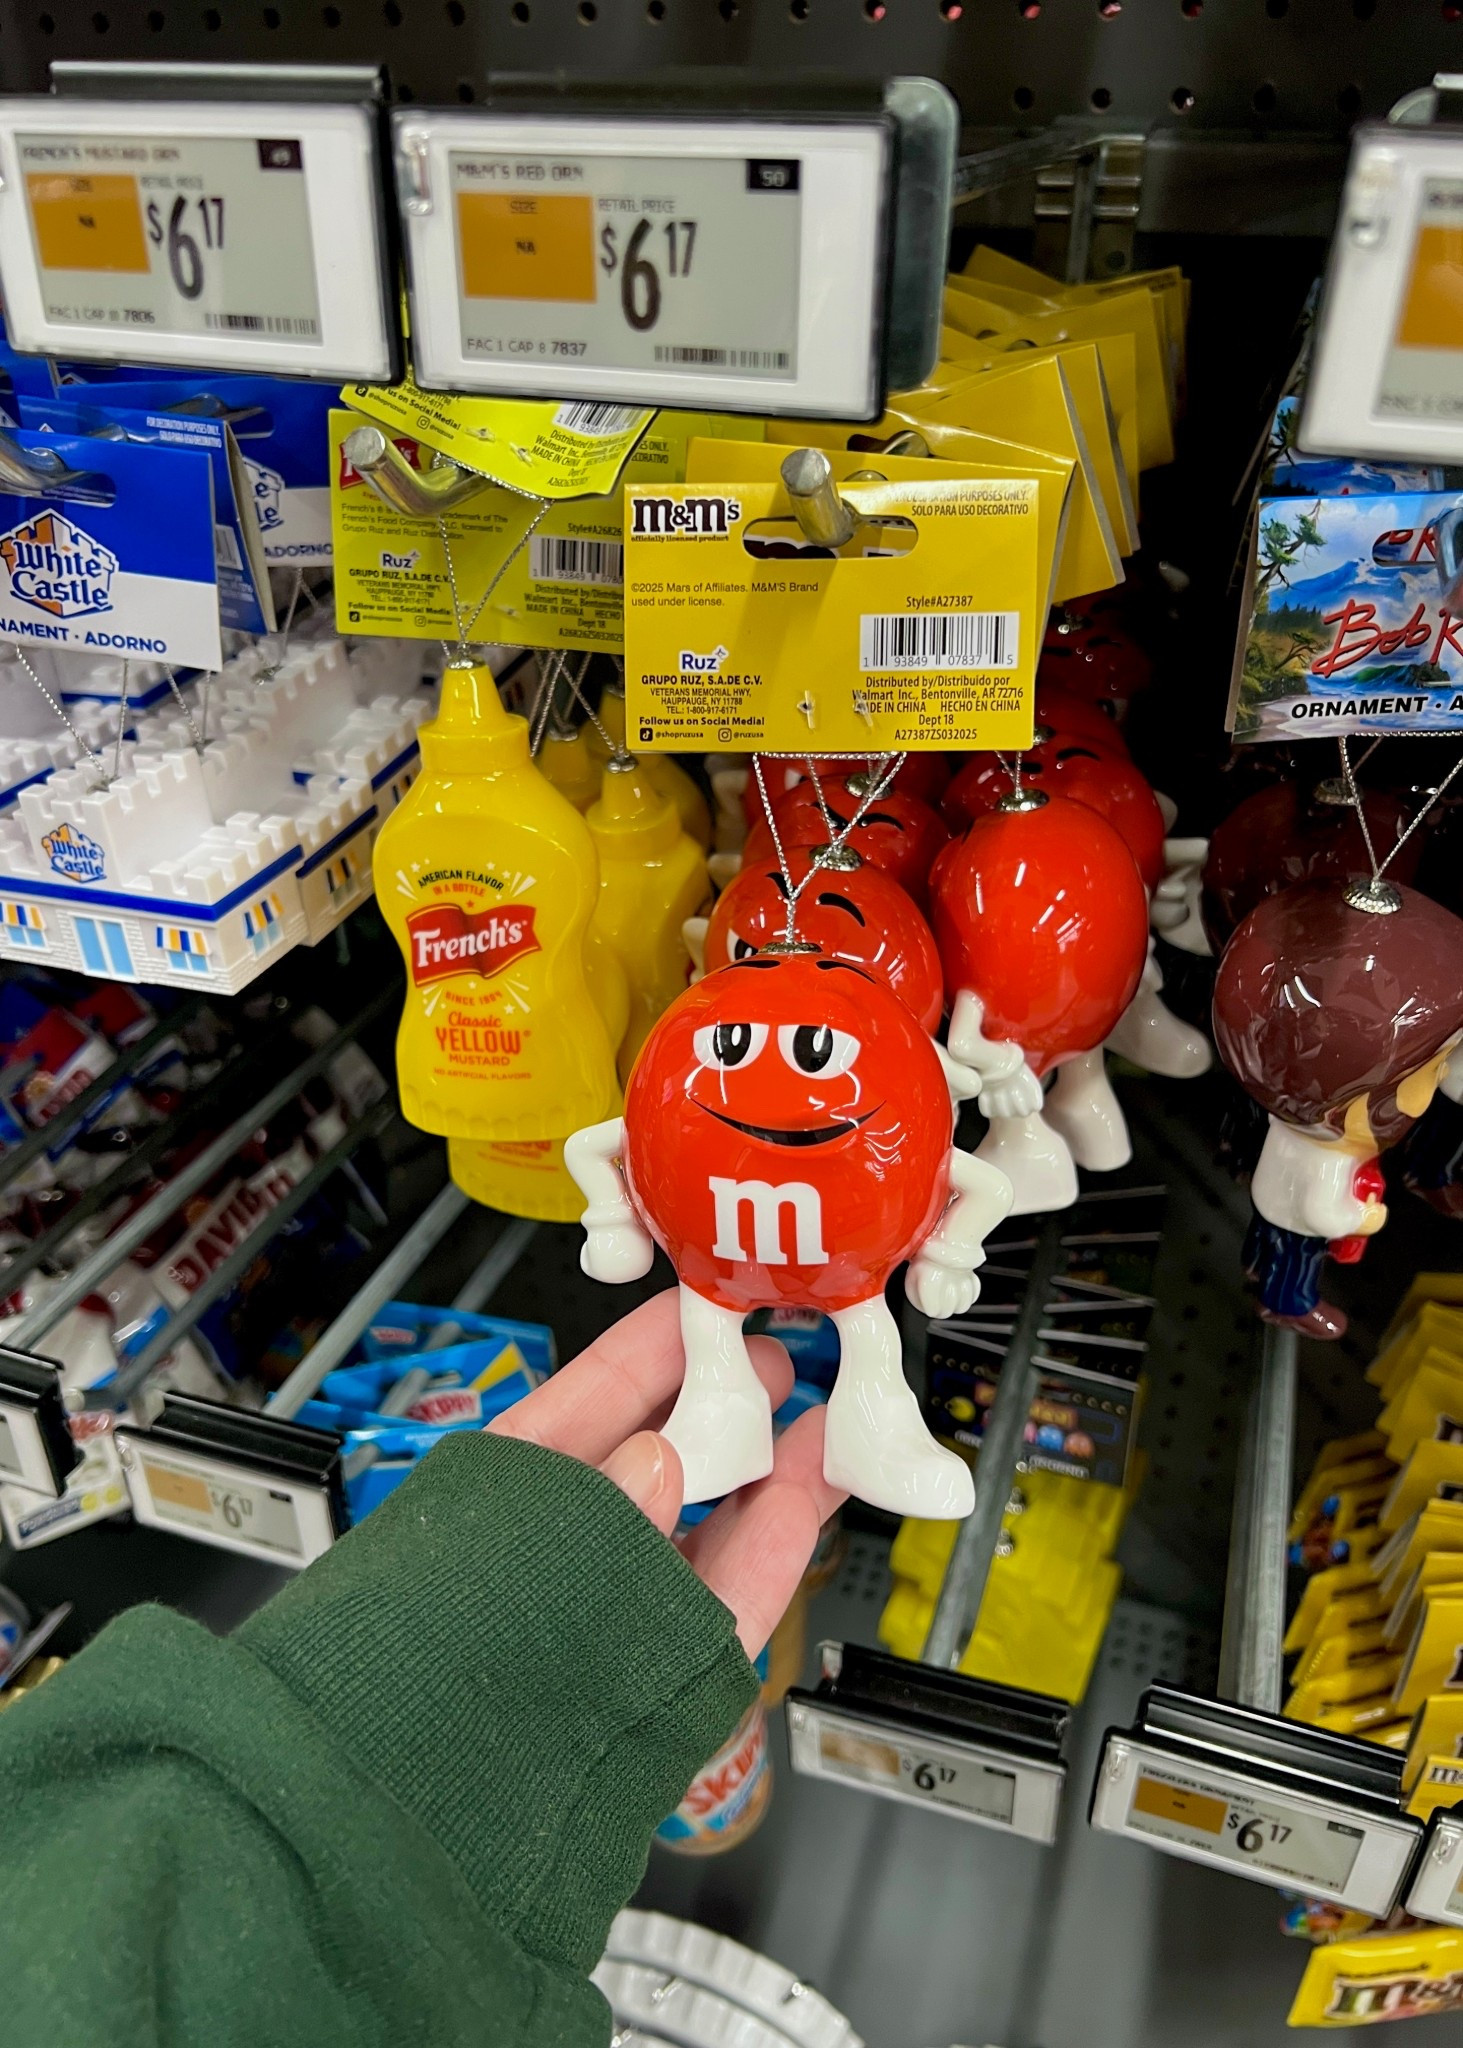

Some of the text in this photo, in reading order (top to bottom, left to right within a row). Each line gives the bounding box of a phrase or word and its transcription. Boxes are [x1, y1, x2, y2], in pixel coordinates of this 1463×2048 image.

[598, 199, 676, 214] RETAIL PRICE
[467, 338, 493, 351] FAC
[508, 341, 534, 354] CAP
[551, 341, 588, 356] 7837
[409, 399, 433, 417] Social
[535, 435, 566, 454] Walmart
[531, 446, 552, 461] MADE
[912, 504, 1028, 517] SOLO PARA USO DECORATIVO
[377, 516, 398, 525] Food
[631, 535, 665, 543] officially
[699, 535, 729, 543] product
[13, 541, 102, 579] White
[382, 553, 412, 569] Ruz
[349, 568, 380, 579] GRUPO
[12, 570, 109, 607] Castle
[667, 583, 690, 592] Mars
[693, 583, 702, 592] of
[705, 583, 748, 592] Affiliates.
[751, 582, 786, 592] M&M'S
[789, 582, 819, 592] Brand
[631, 597, 655, 607] used
[657, 597, 685, 607] under
[688, 597, 725, 607] license.
[906, 595, 973, 610] Style#A27387
[526, 604, 549, 614] MADE
[560, 606, 584, 616] CHINA
[0, 618, 167, 653] NAMENT ADORNO
[1311, 599, 1432, 679] Bob
[682, 653, 717, 670] Ruz
[894, 656, 928, 667] 93849
[948, 655, 982, 666] 07837
[1007, 655, 1013, 665] 5
[641, 675, 763, 687] GRUPO RUZ, S.A.DE C.V.
[866, 675, 1010, 689] Distributed by/Distribuido por
[650, 688, 752, 697] VETERANS MEMORIAL HWY,
[852, 687, 1023, 701] Walmart Inc., Bentonville, AR 72716
[661, 697, 743, 706] HAUPPAUGE, NY 11788
[884, 700, 1021, 713] IN CHINA HECHO EN CHINA
[1292, 696, 1428, 719] ORNAMENT
[667, 706, 737, 714] TEL.: 1-800-917-6171
[639, 717, 671, 725] Follow
[701, 717, 729, 725] Social
[918, 714, 954, 727] Dept 18
[894, 729, 977, 740] A27387ZS032025
[51, 839, 98, 860] White
[51, 855, 104, 877] Castle
[418, 869, 504, 891] AMERICAN FLAVOR
[432, 883, 487, 897] IN A BOTTLE
[413, 917, 523, 967] French's
[448, 1011, 503, 1028] Classic
[435, 1026, 521, 1055] YELLOW
[449, 1054, 511, 1066] MUSTARD
[708, 1175, 830, 1265] m
